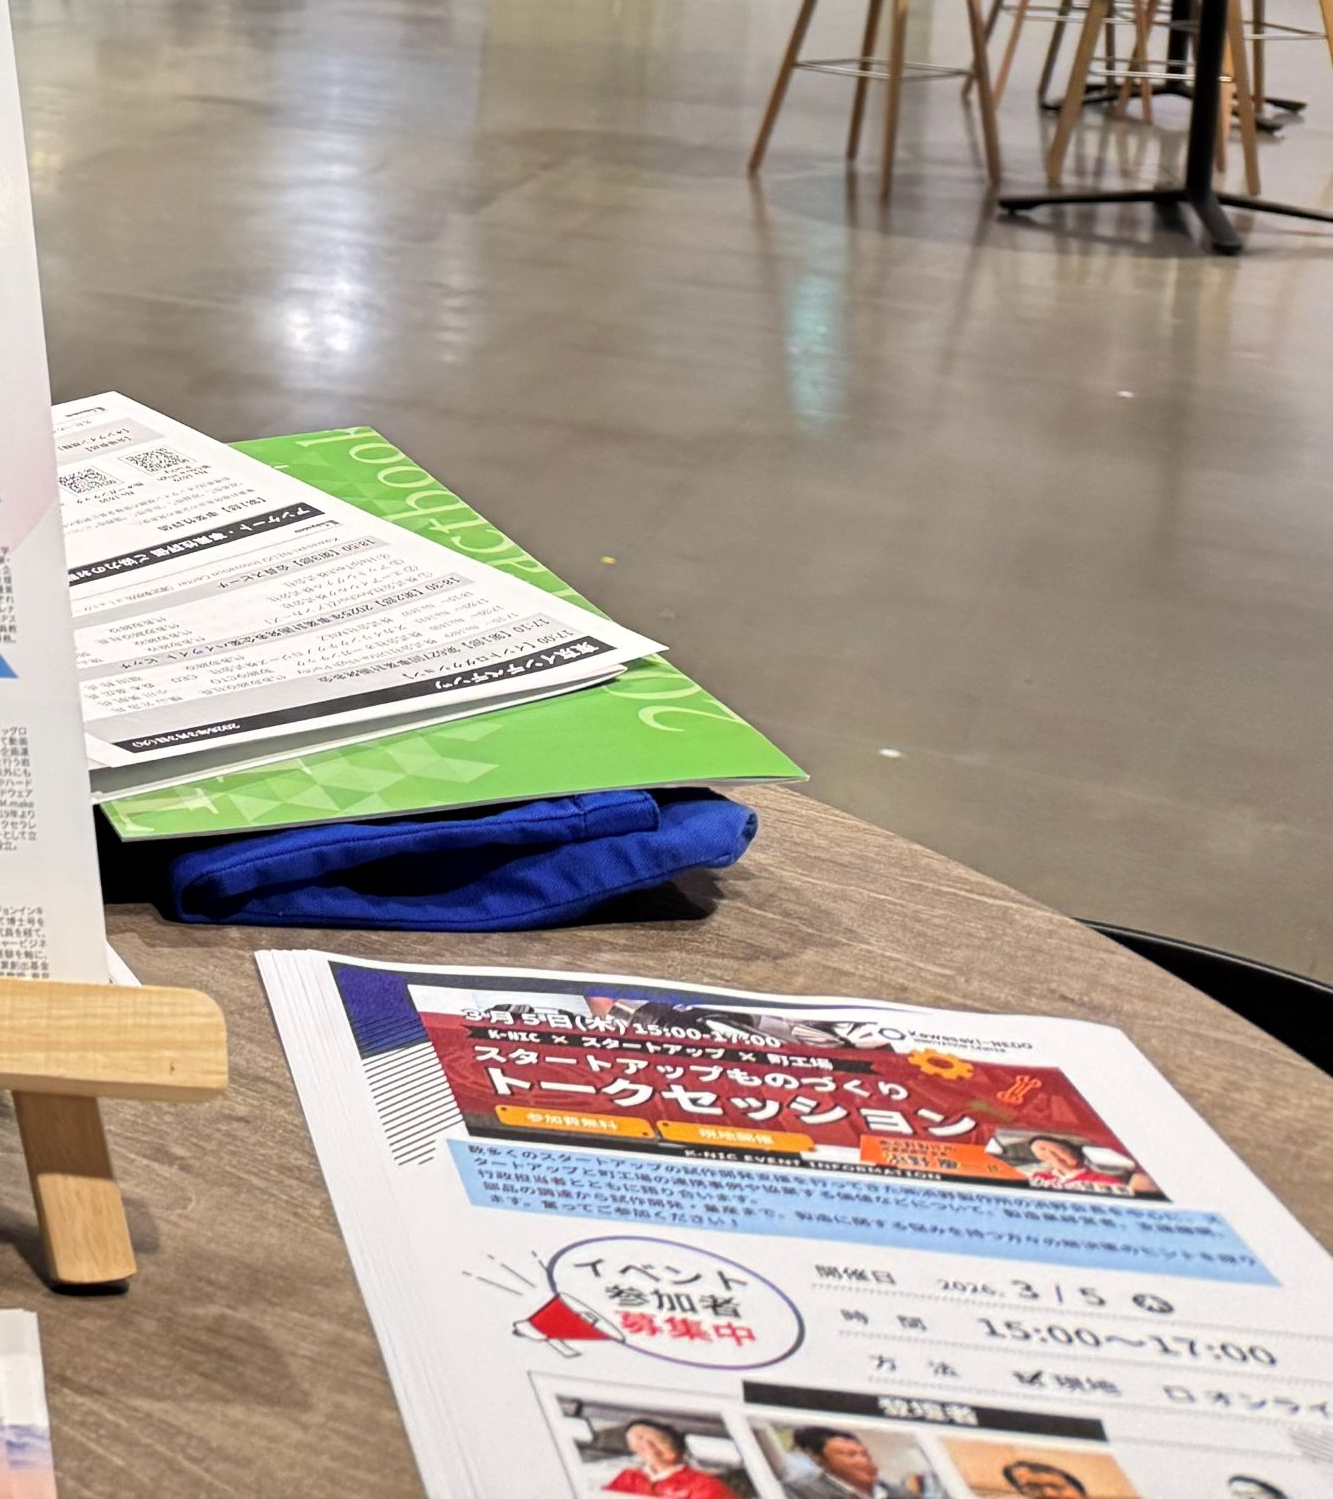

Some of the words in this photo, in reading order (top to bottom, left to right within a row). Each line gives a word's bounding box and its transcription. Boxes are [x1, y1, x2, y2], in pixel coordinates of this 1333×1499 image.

[510, 618, 552, 632] 17:10
[534, 629, 575, 643] 17:00
[486, 1028, 542, 1044] K-NIC
[580, 1035, 727, 1060] スタートアップ
[633, 1022, 783, 1049] 15:00-17:00
[473, 1044, 911, 1101] スタートアップものづくり
[485, 1066, 978, 1138] トークセッション
[683, 1148, 740, 1162] K-NIC
[744, 1155, 802, 1168] EVENT
[806, 1160, 944, 1181] INFORMATION
[573, 1256, 749, 1291] イベント
[605, 1284, 742, 1320] 参加者
[614, 1309, 757, 1348] 募集中
